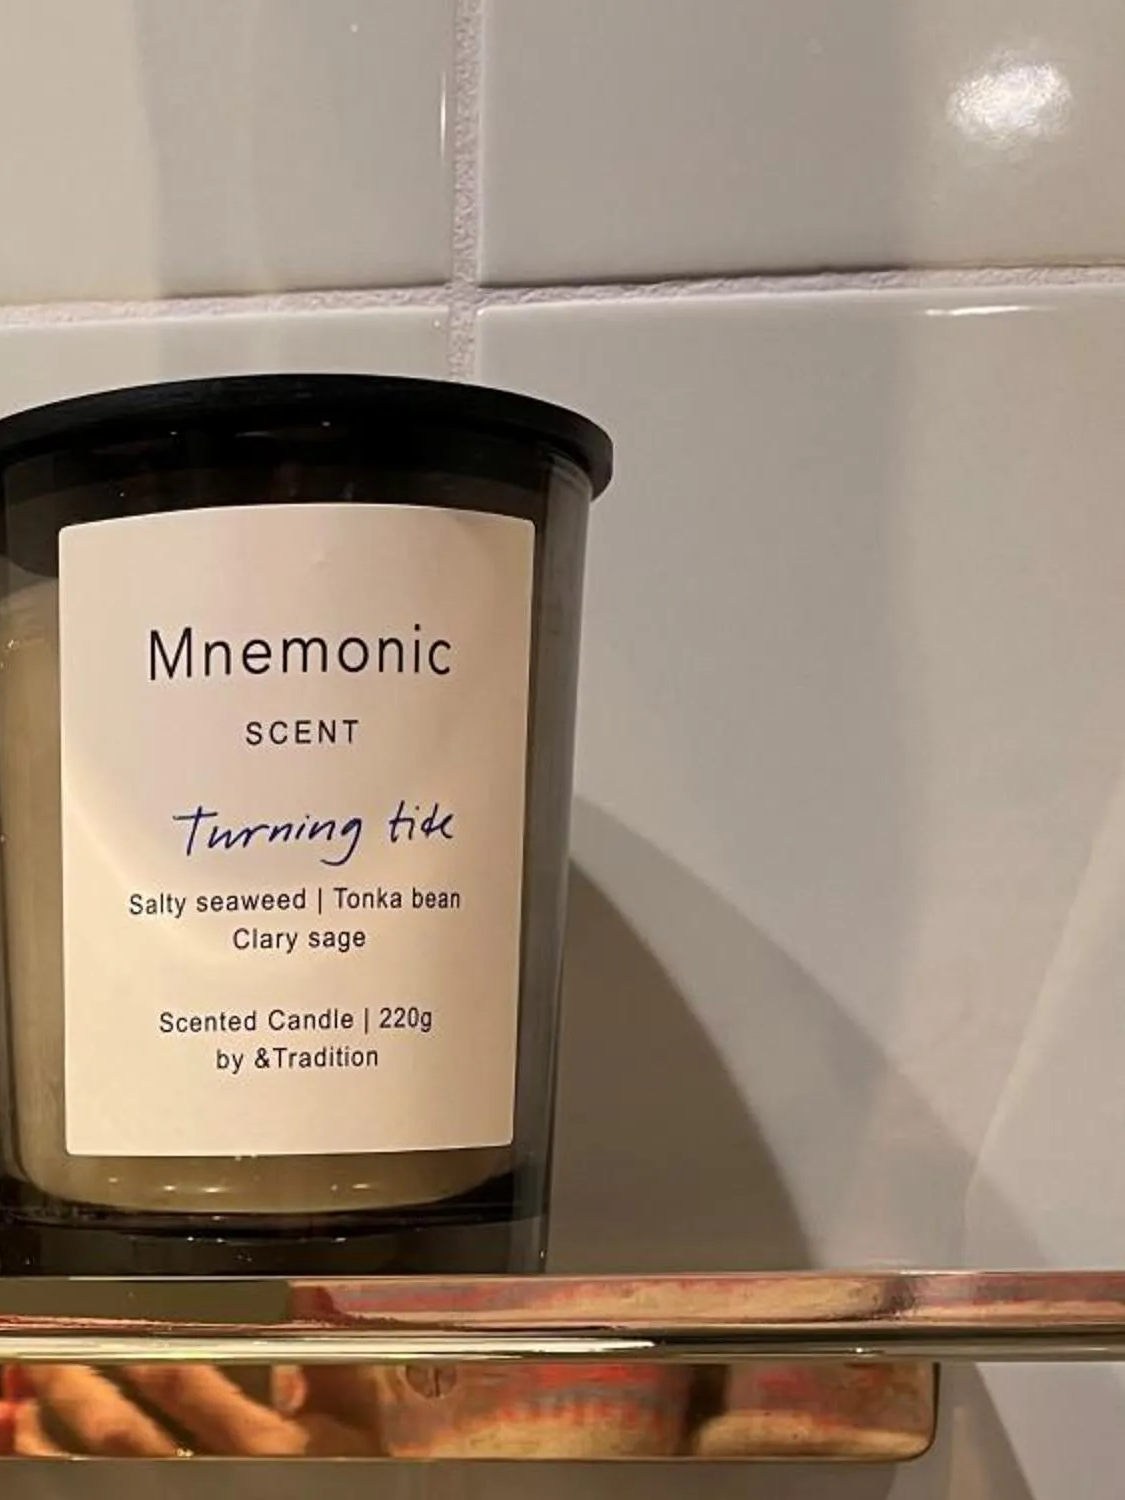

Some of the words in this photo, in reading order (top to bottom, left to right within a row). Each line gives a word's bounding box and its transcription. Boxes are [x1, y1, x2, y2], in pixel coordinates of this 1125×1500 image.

[150, 624, 451, 681] Mnemonic
[246, 720, 359, 746] SCENT
[173, 805, 363, 866] Turning
[388, 800, 454, 843] tide
[129, 892, 187, 919] Salty
[197, 888, 306, 912] seaweed
[333, 887, 402, 909] Tonka
[412, 887, 460, 909] bean
[233, 928, 298, 954] Clary
[308, 931, 366, 952] sage
[159, 1010, 257, 1033] Scented
[268, 1008, 354, 1031] Candle
[379, 1007, 432, 1033] 220g
[217, 1049, 244, 1075] by
[254, 1045, 378, 1069] &Tradition
